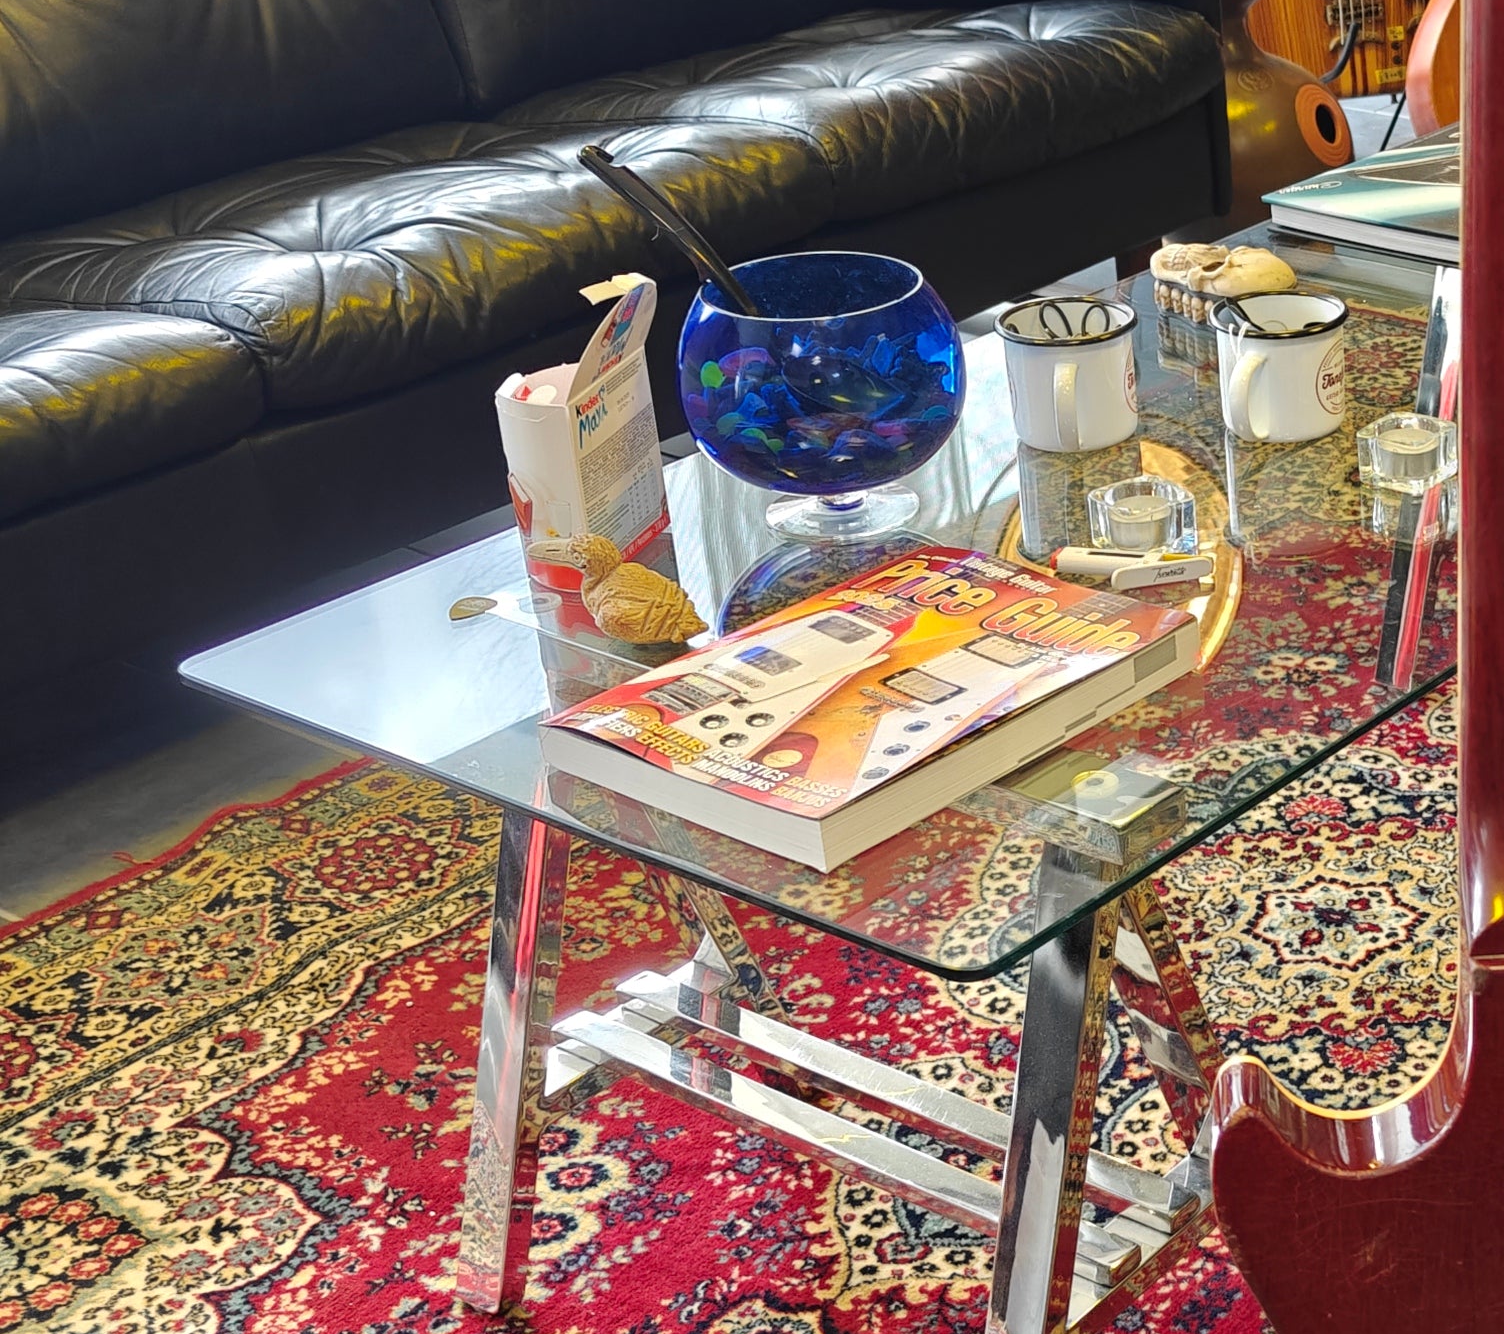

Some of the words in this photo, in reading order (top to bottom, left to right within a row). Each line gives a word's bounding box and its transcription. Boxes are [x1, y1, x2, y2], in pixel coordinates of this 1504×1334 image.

[578, 400, 609, 450] Maxi
[849, 557, 998, 616] Price
[979, 597, 1142, 657] Guide
[958, 555, 1015, 580] Vintage
[1008, 573, 1058, 595] Guitar
[568, 711, 643, 738] AMPFIERS
[635, 732, 700, 766] EFFECTS
[694, 759, 777, 793] MANDOLINS
[771, 784, 833, 809] BANJOS
[587, 703, 650, 726] ELECRIC
[646, 720, 711, 754] GUITARS
[704, 748, 791, 783] ACOUSTICS
[784, 774, 850, 798] BASSES
